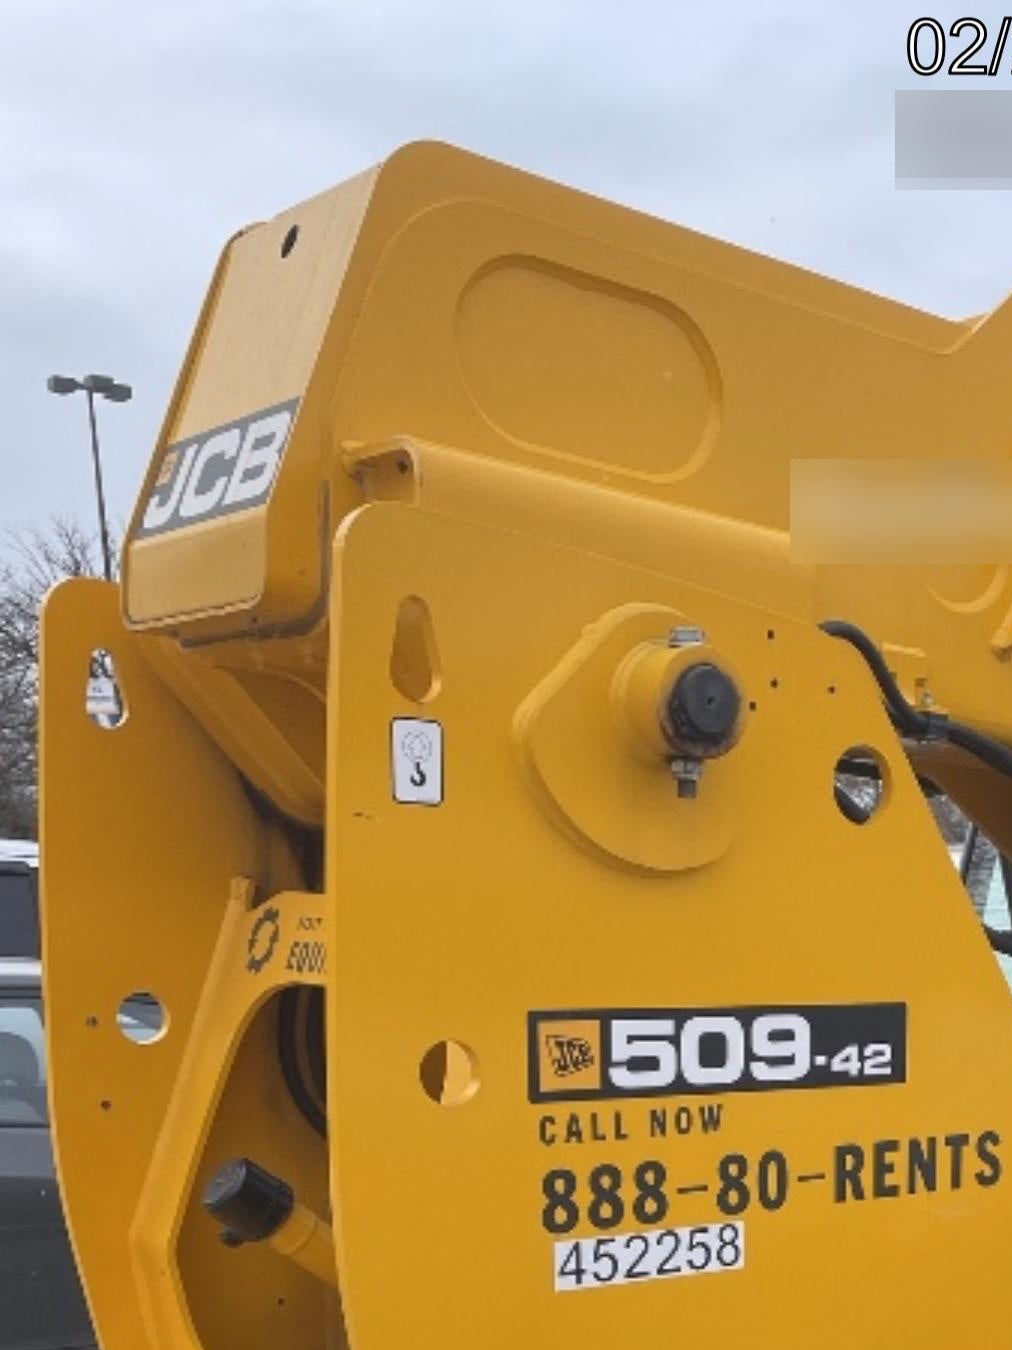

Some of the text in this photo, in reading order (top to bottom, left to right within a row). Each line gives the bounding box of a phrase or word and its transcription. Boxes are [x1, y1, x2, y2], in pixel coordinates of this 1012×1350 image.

[143, 410, 292, 529] JCB
[539, 1104, 724, 1145] CALL NOW
[541, 1130, 1003, 1234] 888-80-RENTS
[558, 1223, 741, 1285] 452258
